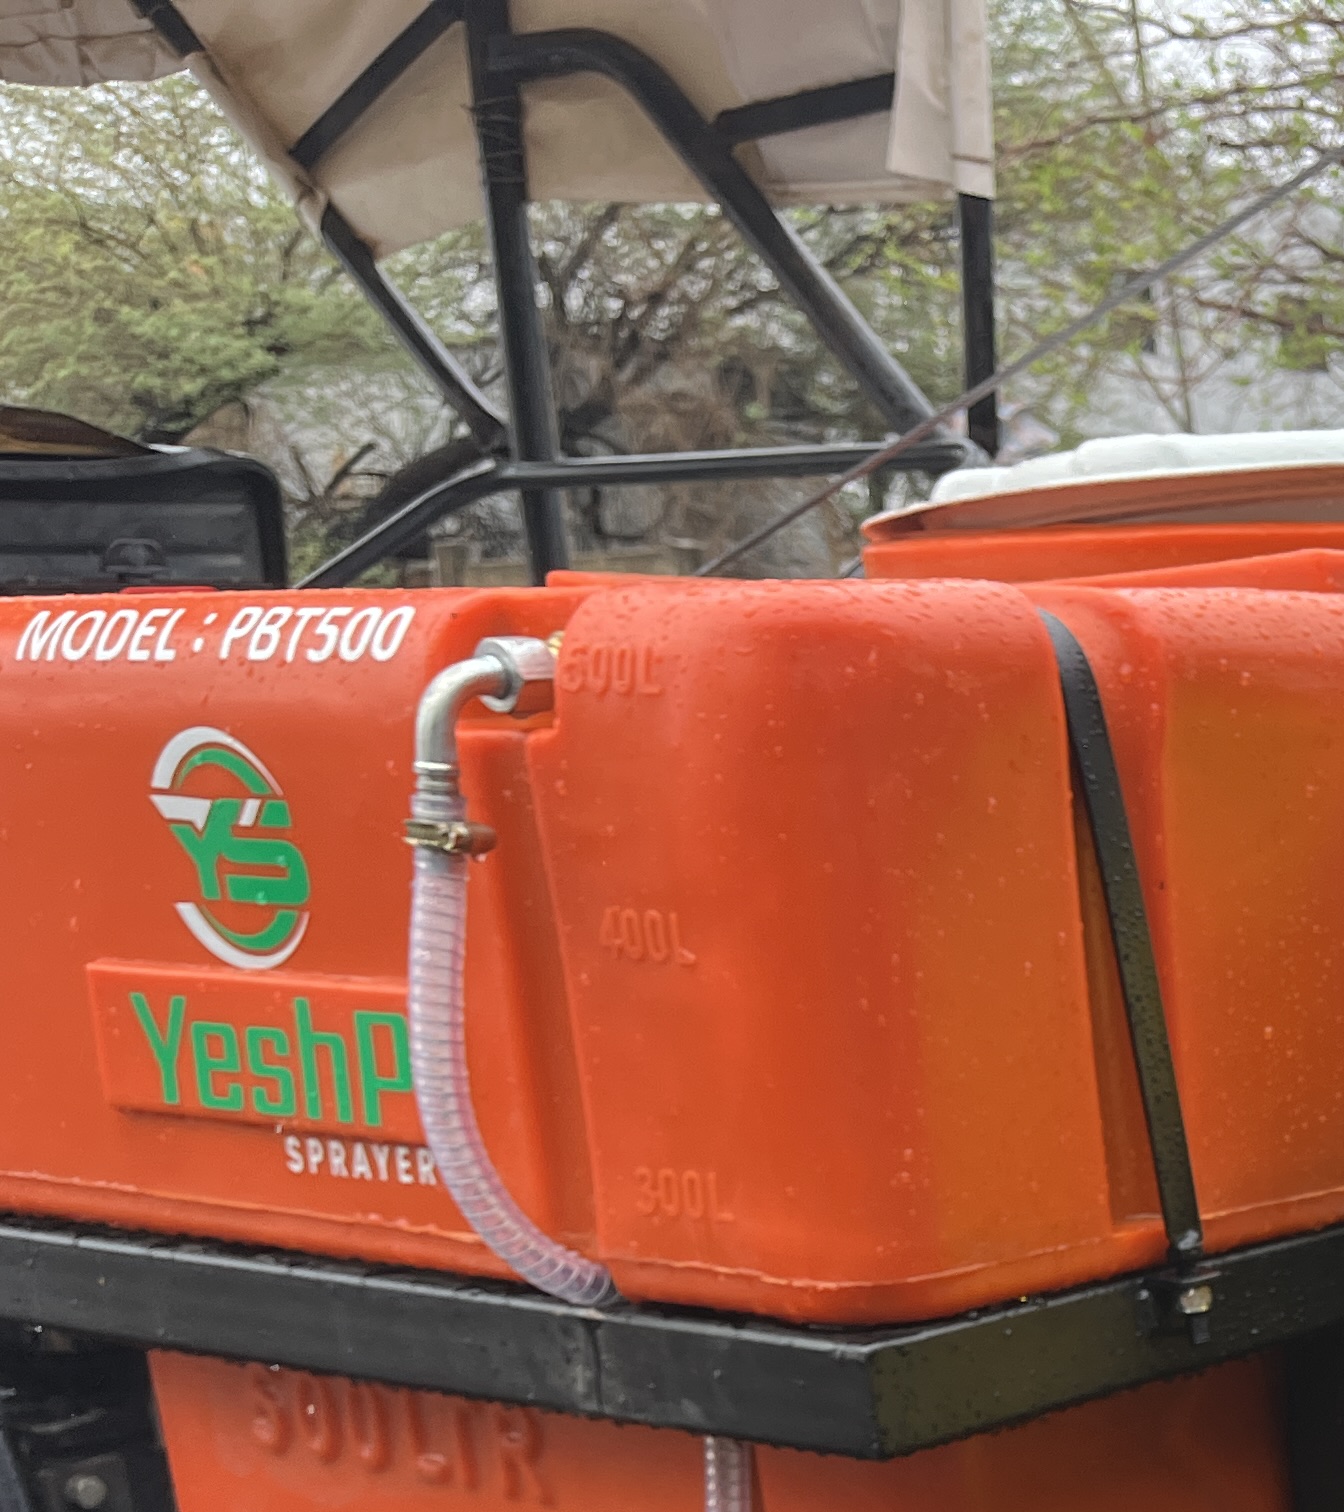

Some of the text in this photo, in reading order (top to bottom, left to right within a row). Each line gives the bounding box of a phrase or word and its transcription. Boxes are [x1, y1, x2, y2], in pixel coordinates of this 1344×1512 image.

[15, 607, 186, 662] MODEL
[218, 605, 416, 664] PBT500
[601, 905, 698, 966] 400L
[633, 1164, 736, 1222] 300L
